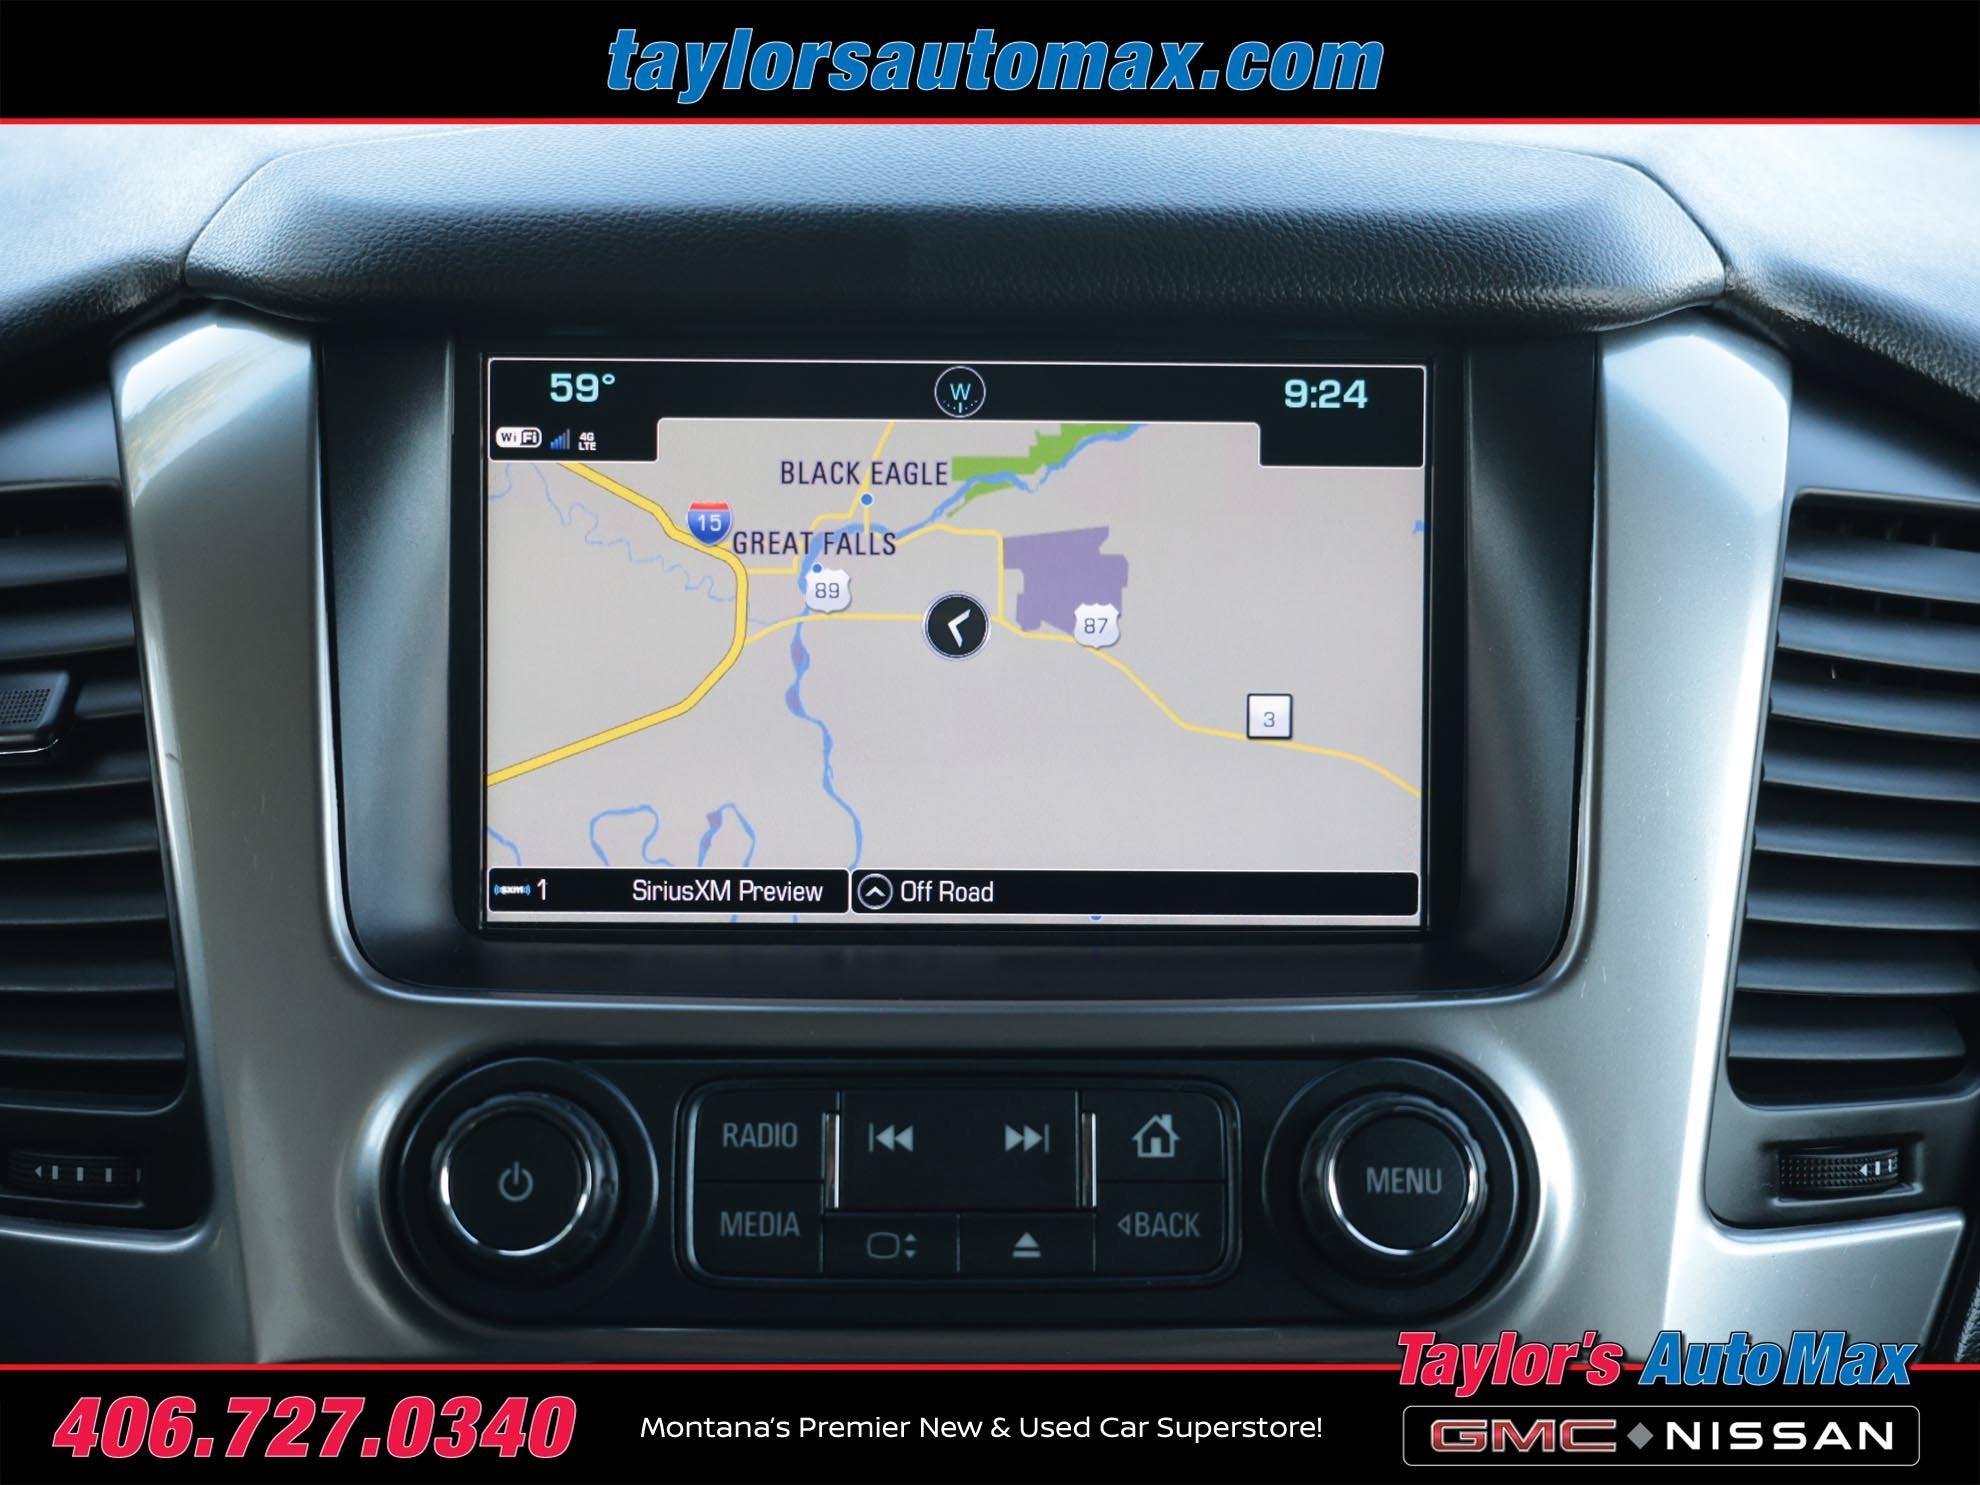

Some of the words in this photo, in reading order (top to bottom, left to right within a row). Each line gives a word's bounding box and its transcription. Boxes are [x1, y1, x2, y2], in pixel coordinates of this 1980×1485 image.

[550, 373, 616, 403] 59°
[949, 382, 972, 402] W
[1284, 379, 1368, 409] 9:24
[579, 432, 594, 442] 4G
[579, 442, 597, 451] LTE
[780, 461, 861, 485] BLACK
[871, 462, 948, 485] EAGLE
[698, 514, 723, 532] 15
[732, 531, 814, 555] GREAT
[823, 531, 897, 555] FALLS
[815, 582, 841, 600] 89
[1084, 617, 1109, 635] 87
[1263, 711, 1275, 728] 3
[537, 878, 547, 901] 1
[632, 879, 731, 902] SiriusXM
[739, 880, 823, 902] Preview
[900, 880, 932, 902] Off
[938, 880, 995, 903] Road
[722, 1122, 799, 1149] RADIO
[1366, 1167, 1443, 1195] MENU
[719, 1211, 801, 1239] MEDIA
[1135, 1213, 1200, 1239] BACK
